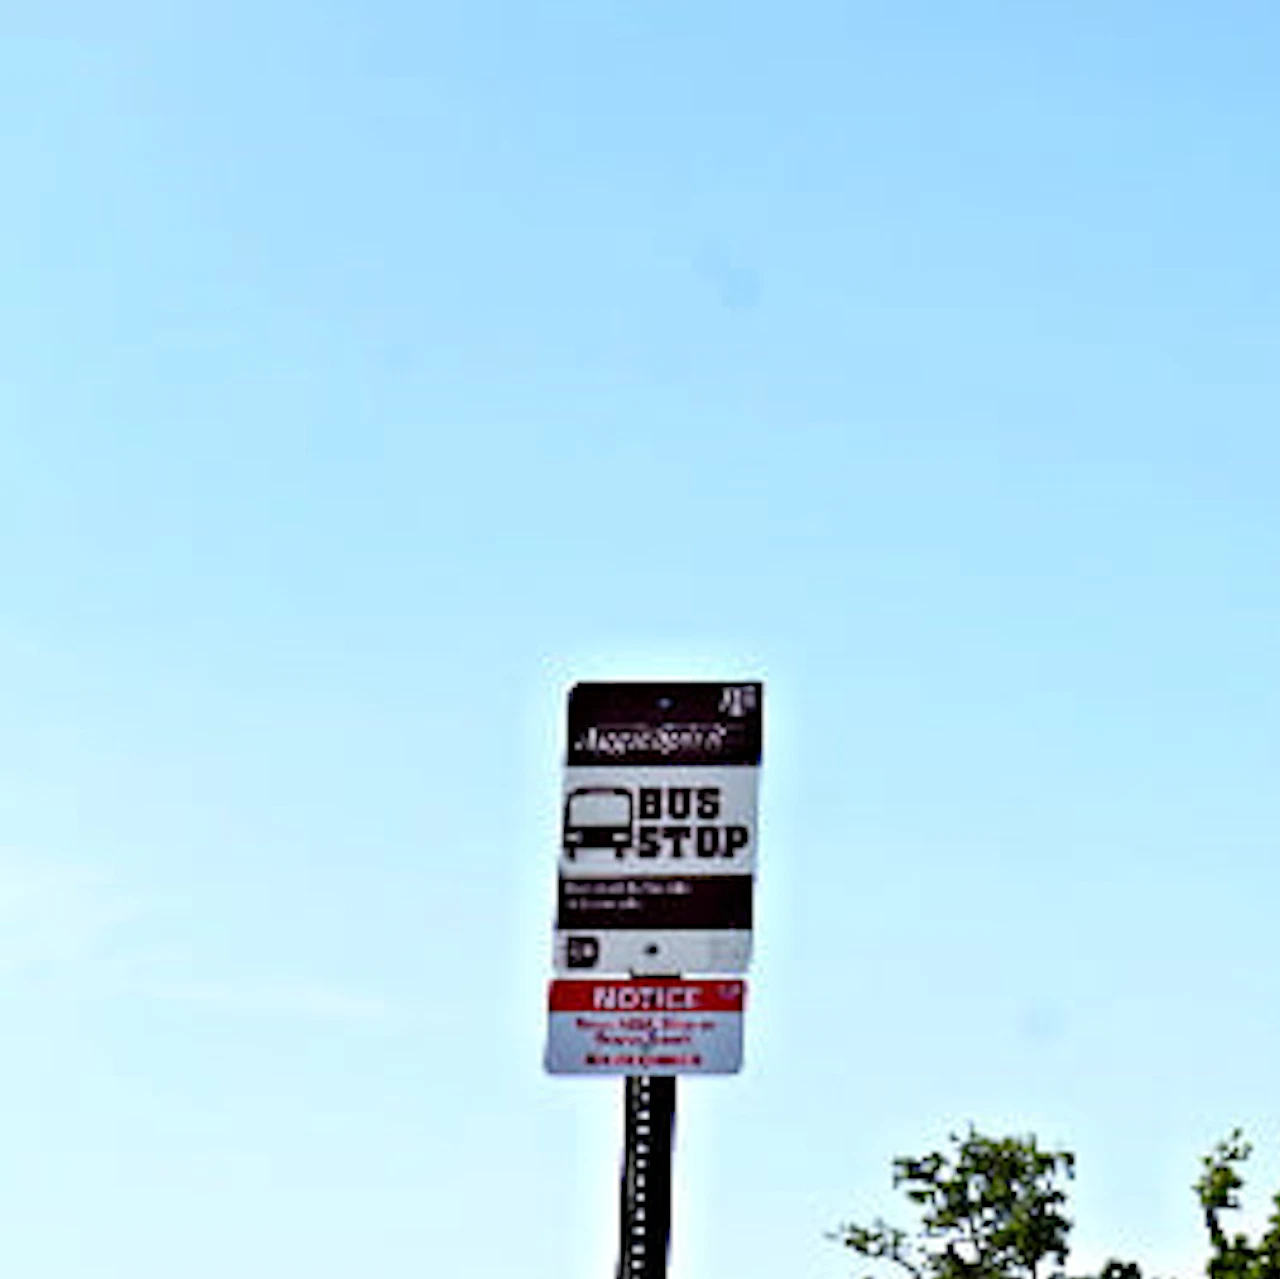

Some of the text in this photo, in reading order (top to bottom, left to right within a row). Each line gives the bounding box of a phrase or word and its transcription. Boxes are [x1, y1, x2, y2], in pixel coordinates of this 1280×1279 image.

[639, 787, 720, 820] BUS
[638, 826, 749, 858] STOP
[592, 985, 702, 1010] NOTICE
